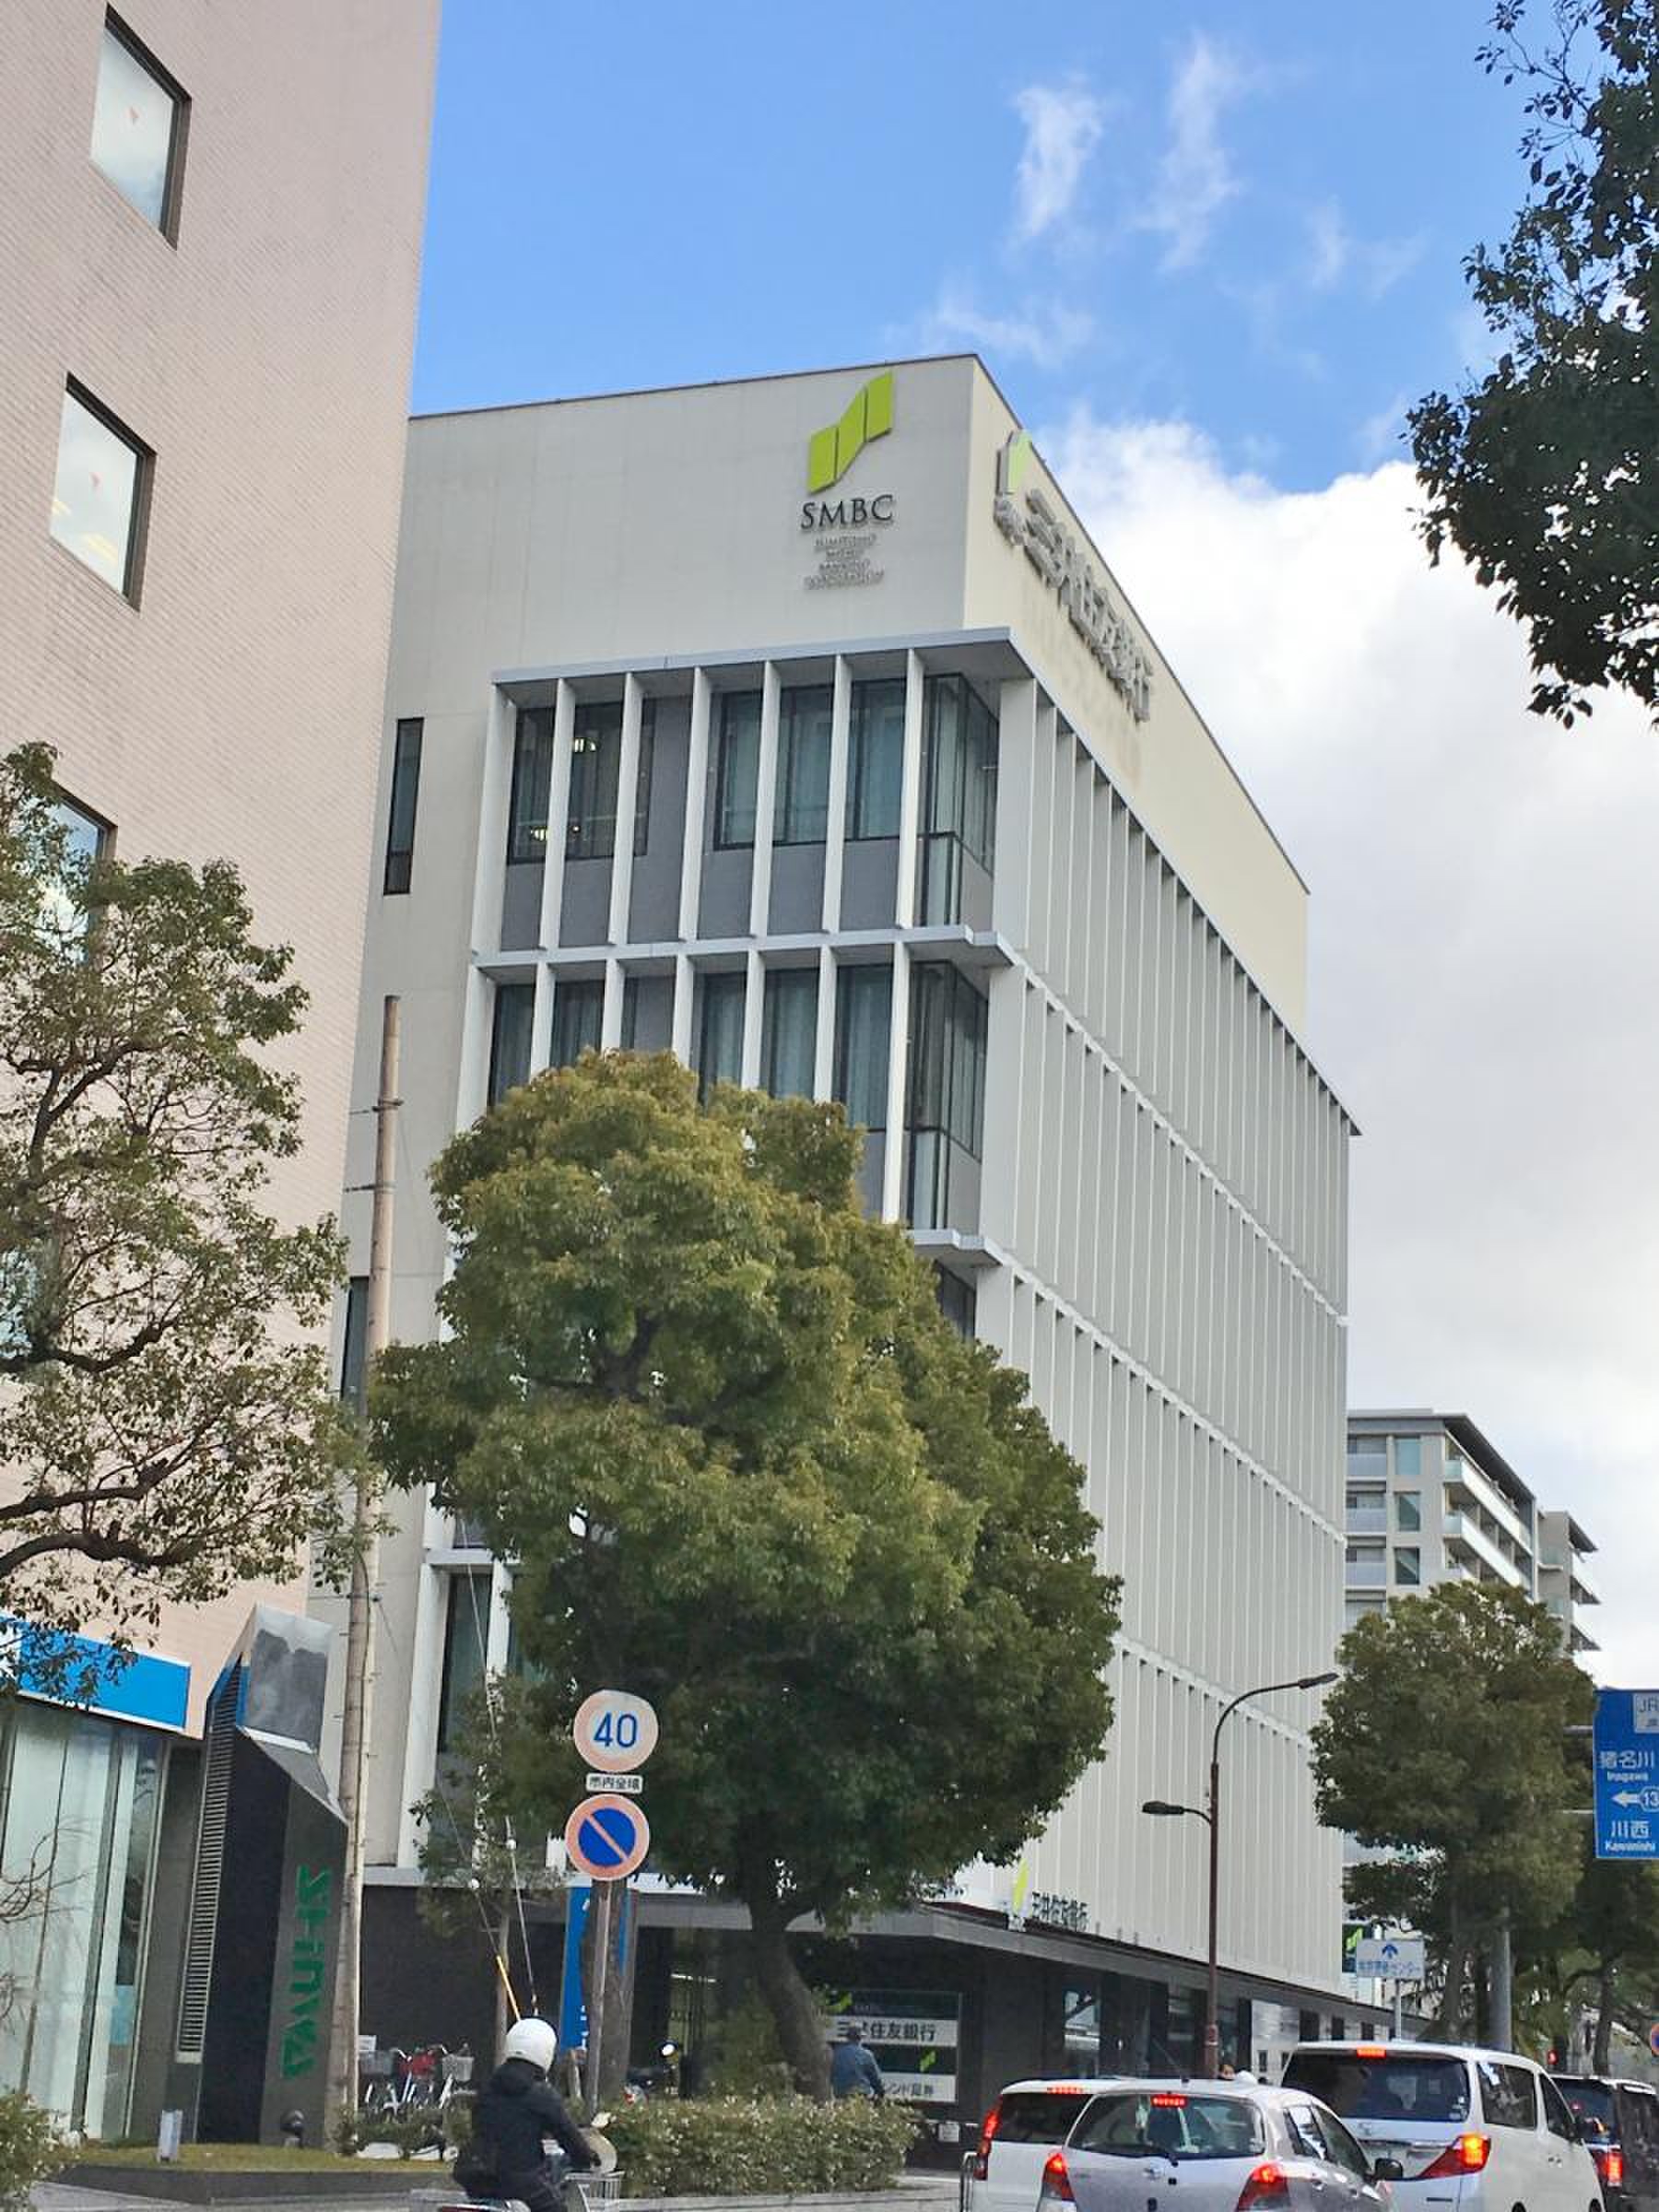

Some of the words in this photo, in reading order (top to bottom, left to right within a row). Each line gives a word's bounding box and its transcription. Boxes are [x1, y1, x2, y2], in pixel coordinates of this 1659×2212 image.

[800, 494, 894, 530] SMBC
[594, 1712, 638, 1747] 40
[1611, 1820, 1650, 1839] 川西
